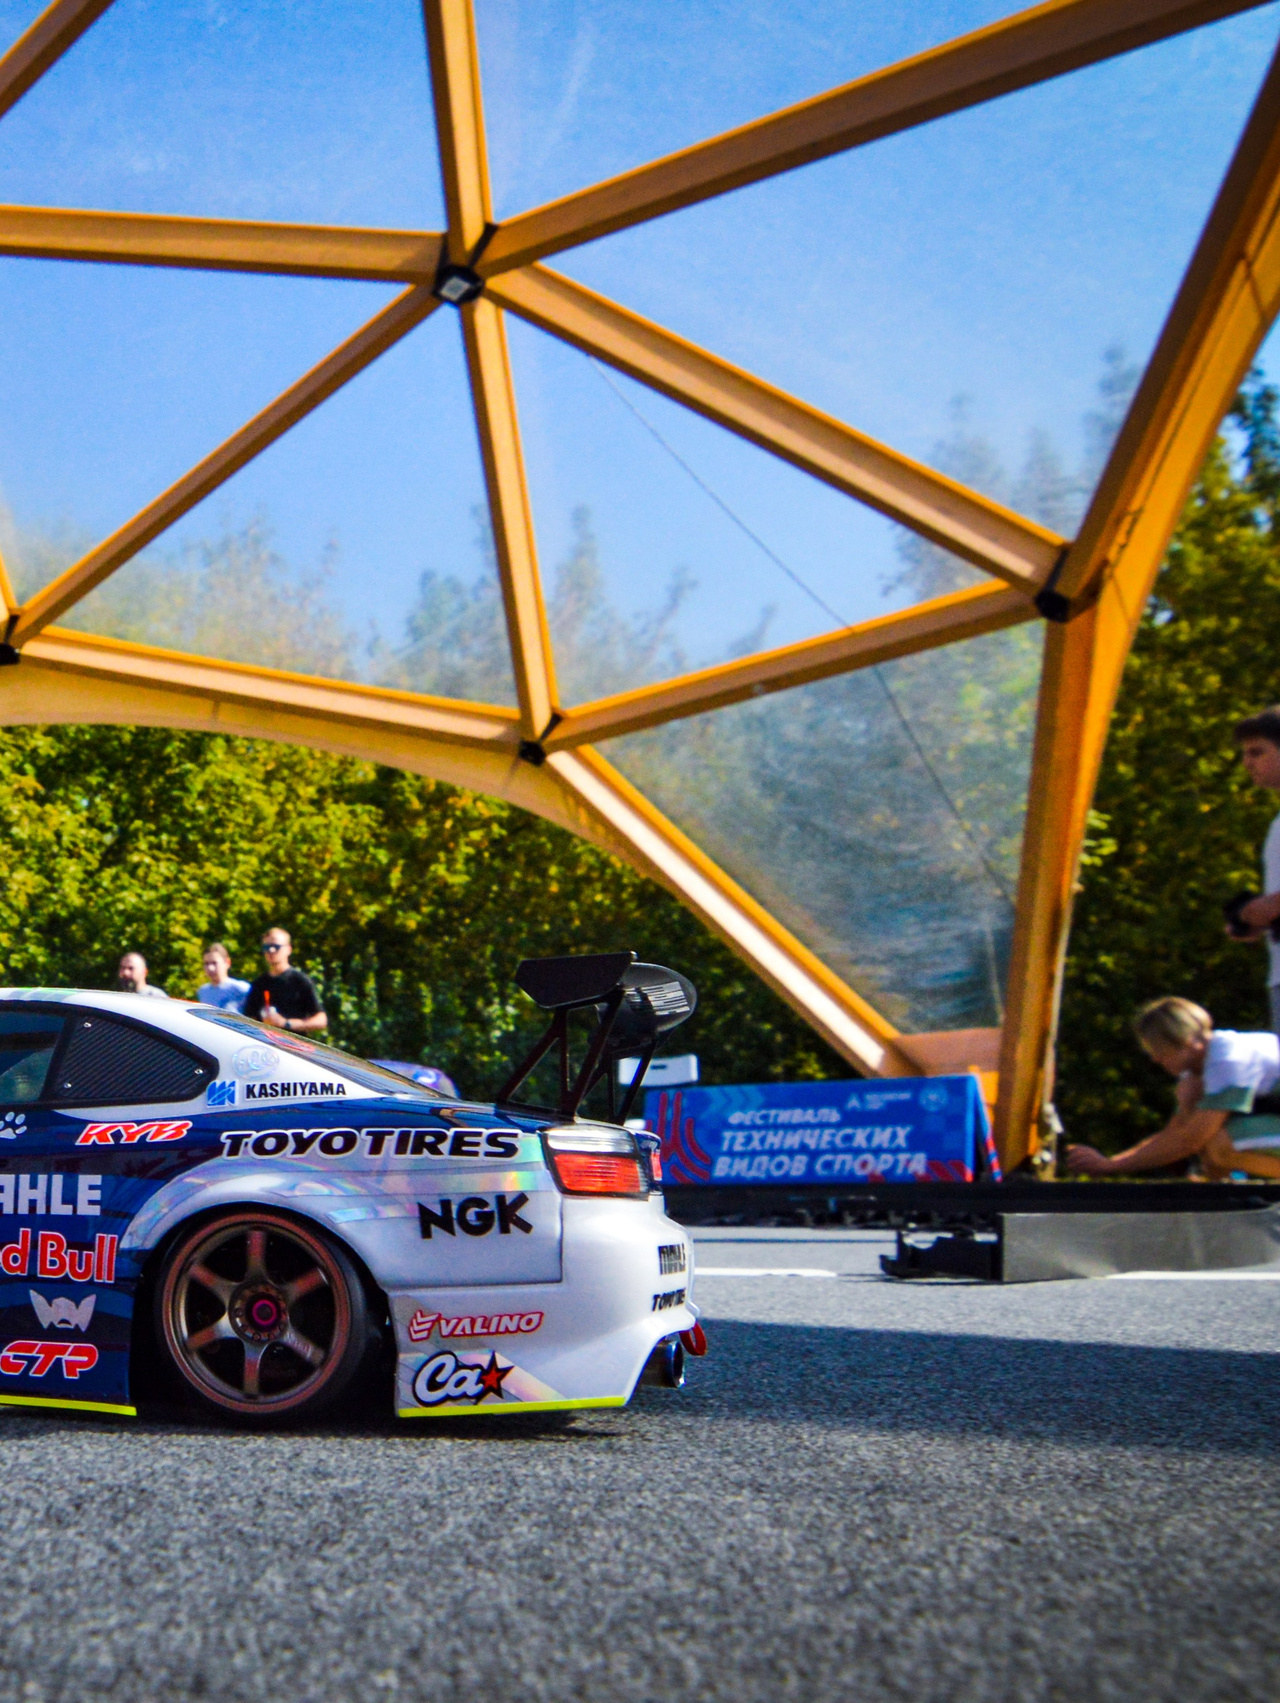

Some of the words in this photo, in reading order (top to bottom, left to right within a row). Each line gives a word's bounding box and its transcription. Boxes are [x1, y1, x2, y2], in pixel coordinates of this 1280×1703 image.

[245, 1082, 347, 1099] KASHIYAMA
[728, 1108, 841, 1125] ФЕСТИВАЛЬ
[75, 1121, 192, 1145] KYB
[222, 1129, 359, 1158] TOYO
[364, 1129, 520, 1159] TIRES
[722, 1125, 912, 1151] ТЕХНИЧЕСКИХ
[713, 1154, 808, 1178] ВИДОВ
[815, 1152, 926, 1175] СПОРТА
[417, 1192, 533, 1239] NGK
[37, 1231, 118, 1284] Bull
[439, 1312, 544, 1338] VALINO
